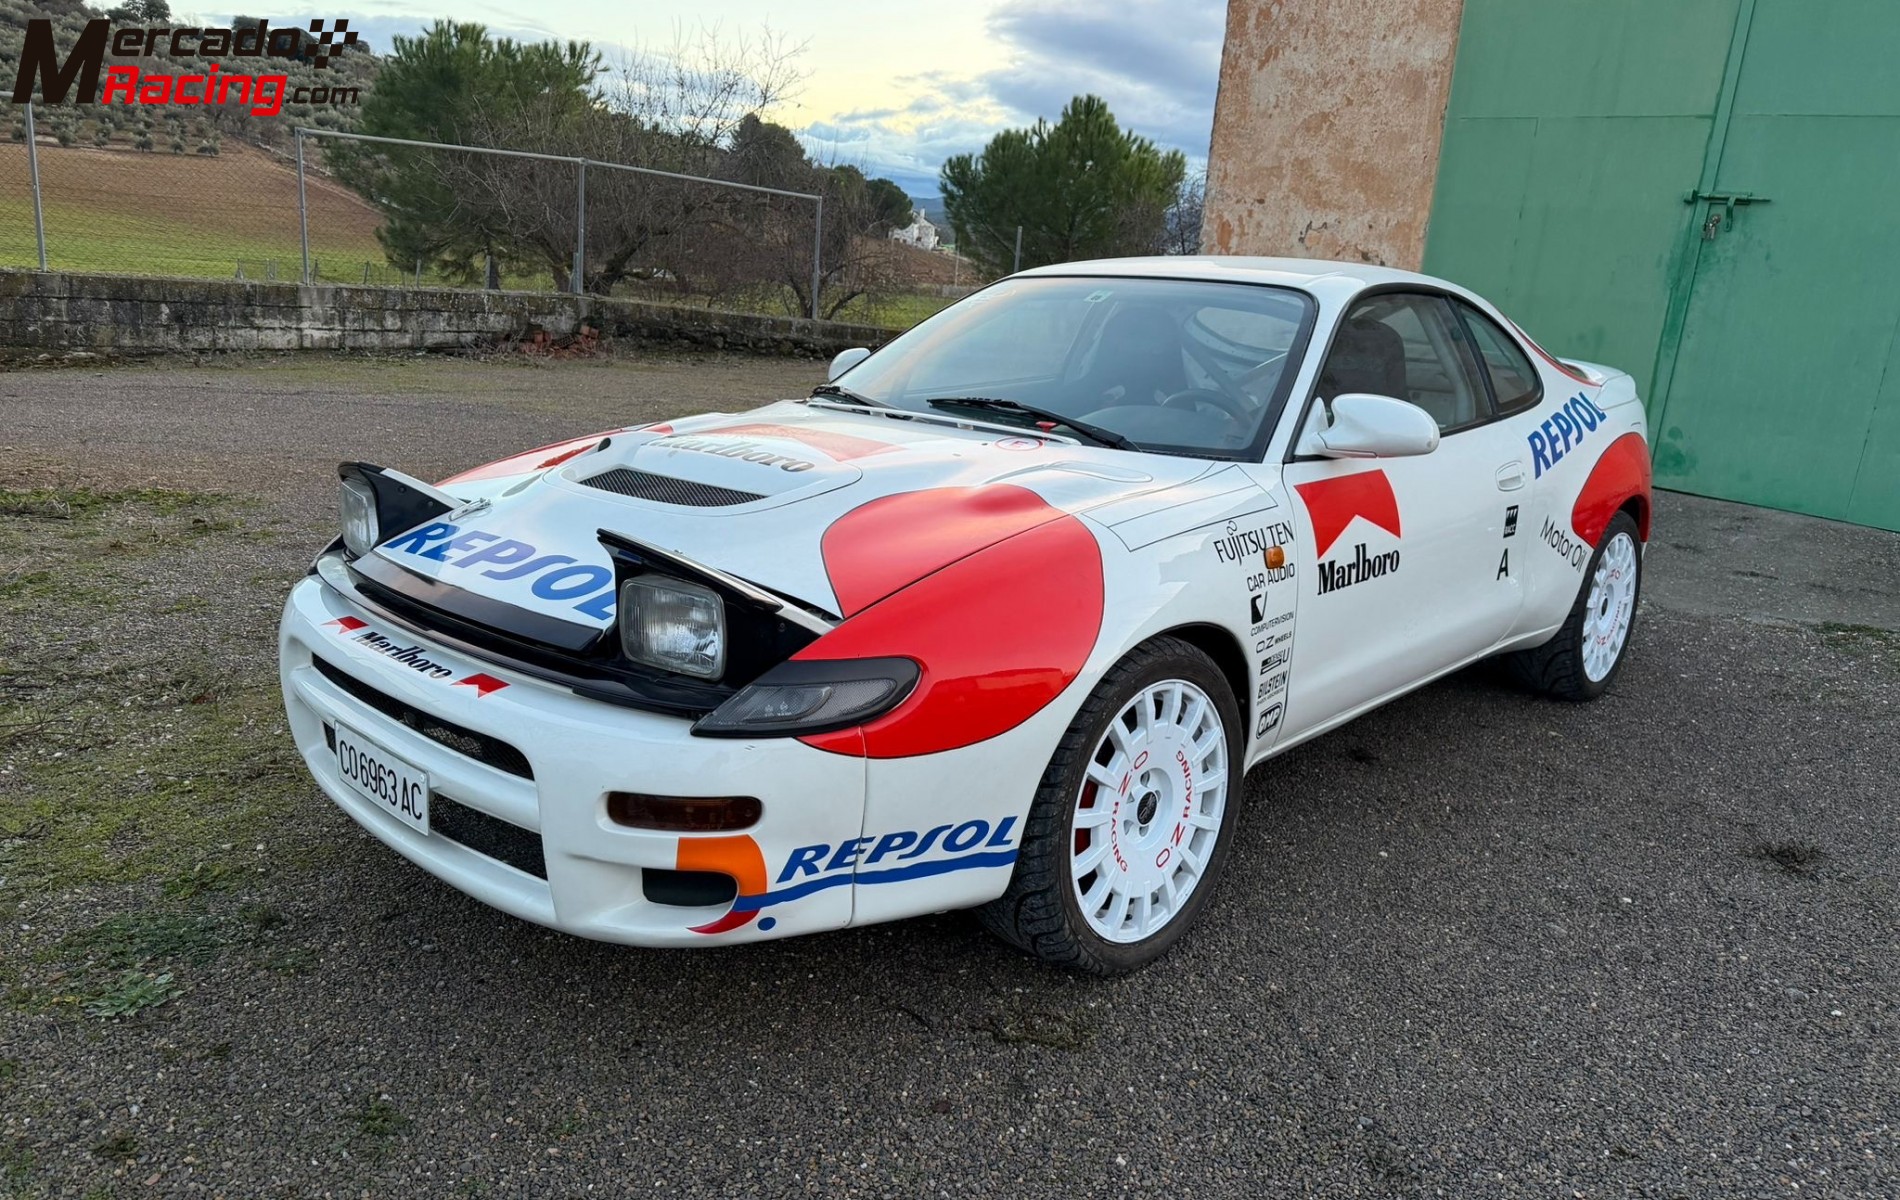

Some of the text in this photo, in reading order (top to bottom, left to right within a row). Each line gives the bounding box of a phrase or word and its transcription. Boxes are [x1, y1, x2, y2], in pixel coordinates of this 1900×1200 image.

[1527, 391, 1607, 480] REPSOL
[1213, 520, 1295, 566] FUJITSU TEN
[1317, 543, 1401, 596] Marlboro
[1497, 548, 1509, 581] A
[1540, 514, 1588, 574] Motor Oil
[1247, 562, 1296, 592] CAR AUDIO
[352, 630, 453, 680] Marlboro
[1257, 669, 1288, 700] BILSTEIN
[1175, 750, 1193, 819] RACING
[775, 815, 1018, 884] REPSOL
[1110, 801, 1128, 873] RACING
